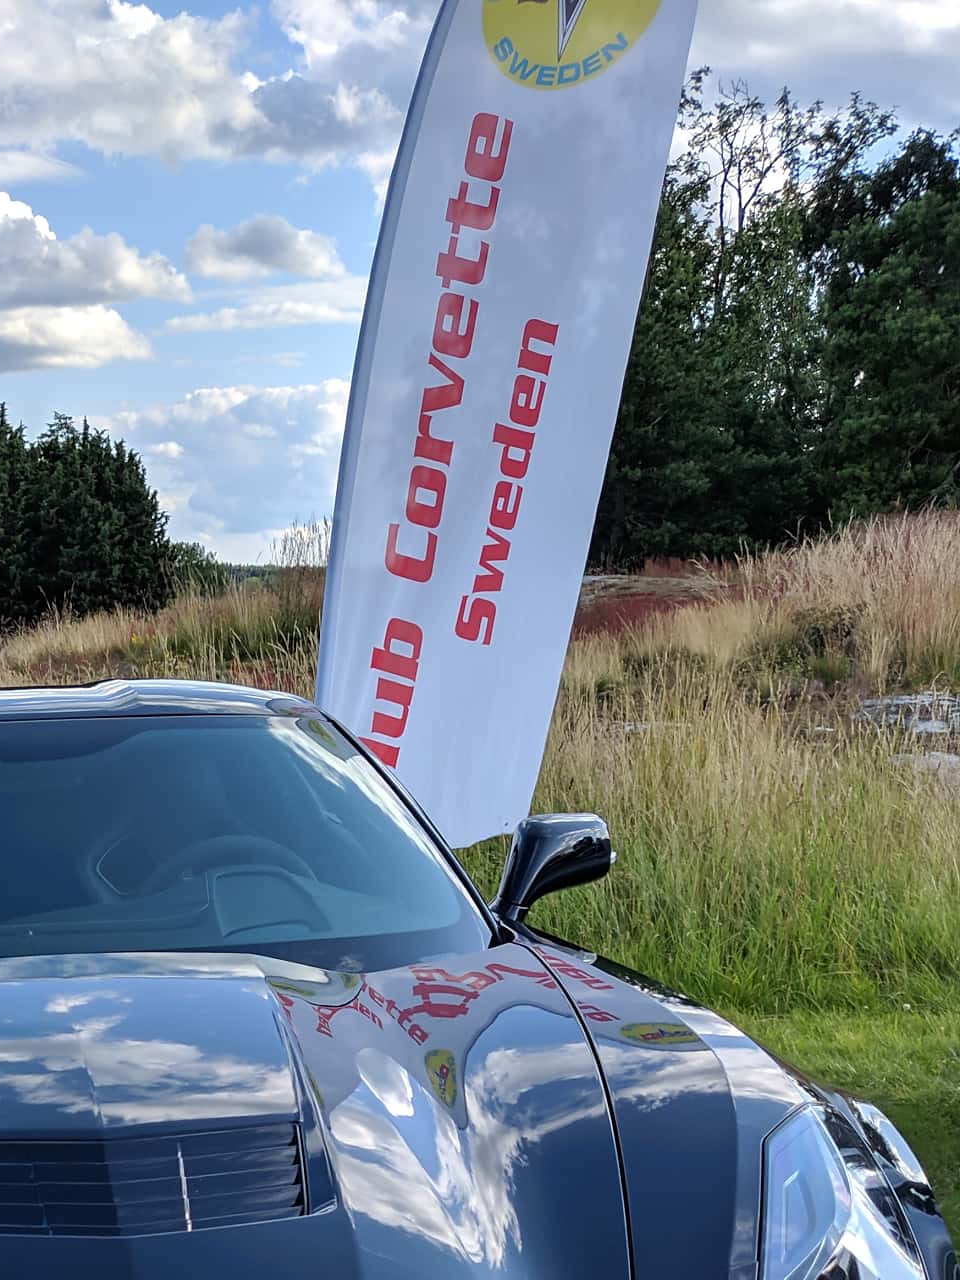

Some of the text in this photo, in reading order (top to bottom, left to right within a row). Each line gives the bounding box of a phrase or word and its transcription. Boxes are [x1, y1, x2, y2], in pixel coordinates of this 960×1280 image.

[493, 32, 629, 86] SWEDEN
[384, 112, 514, 584] Corvette
[454, 318, 560, 646] Sweden
